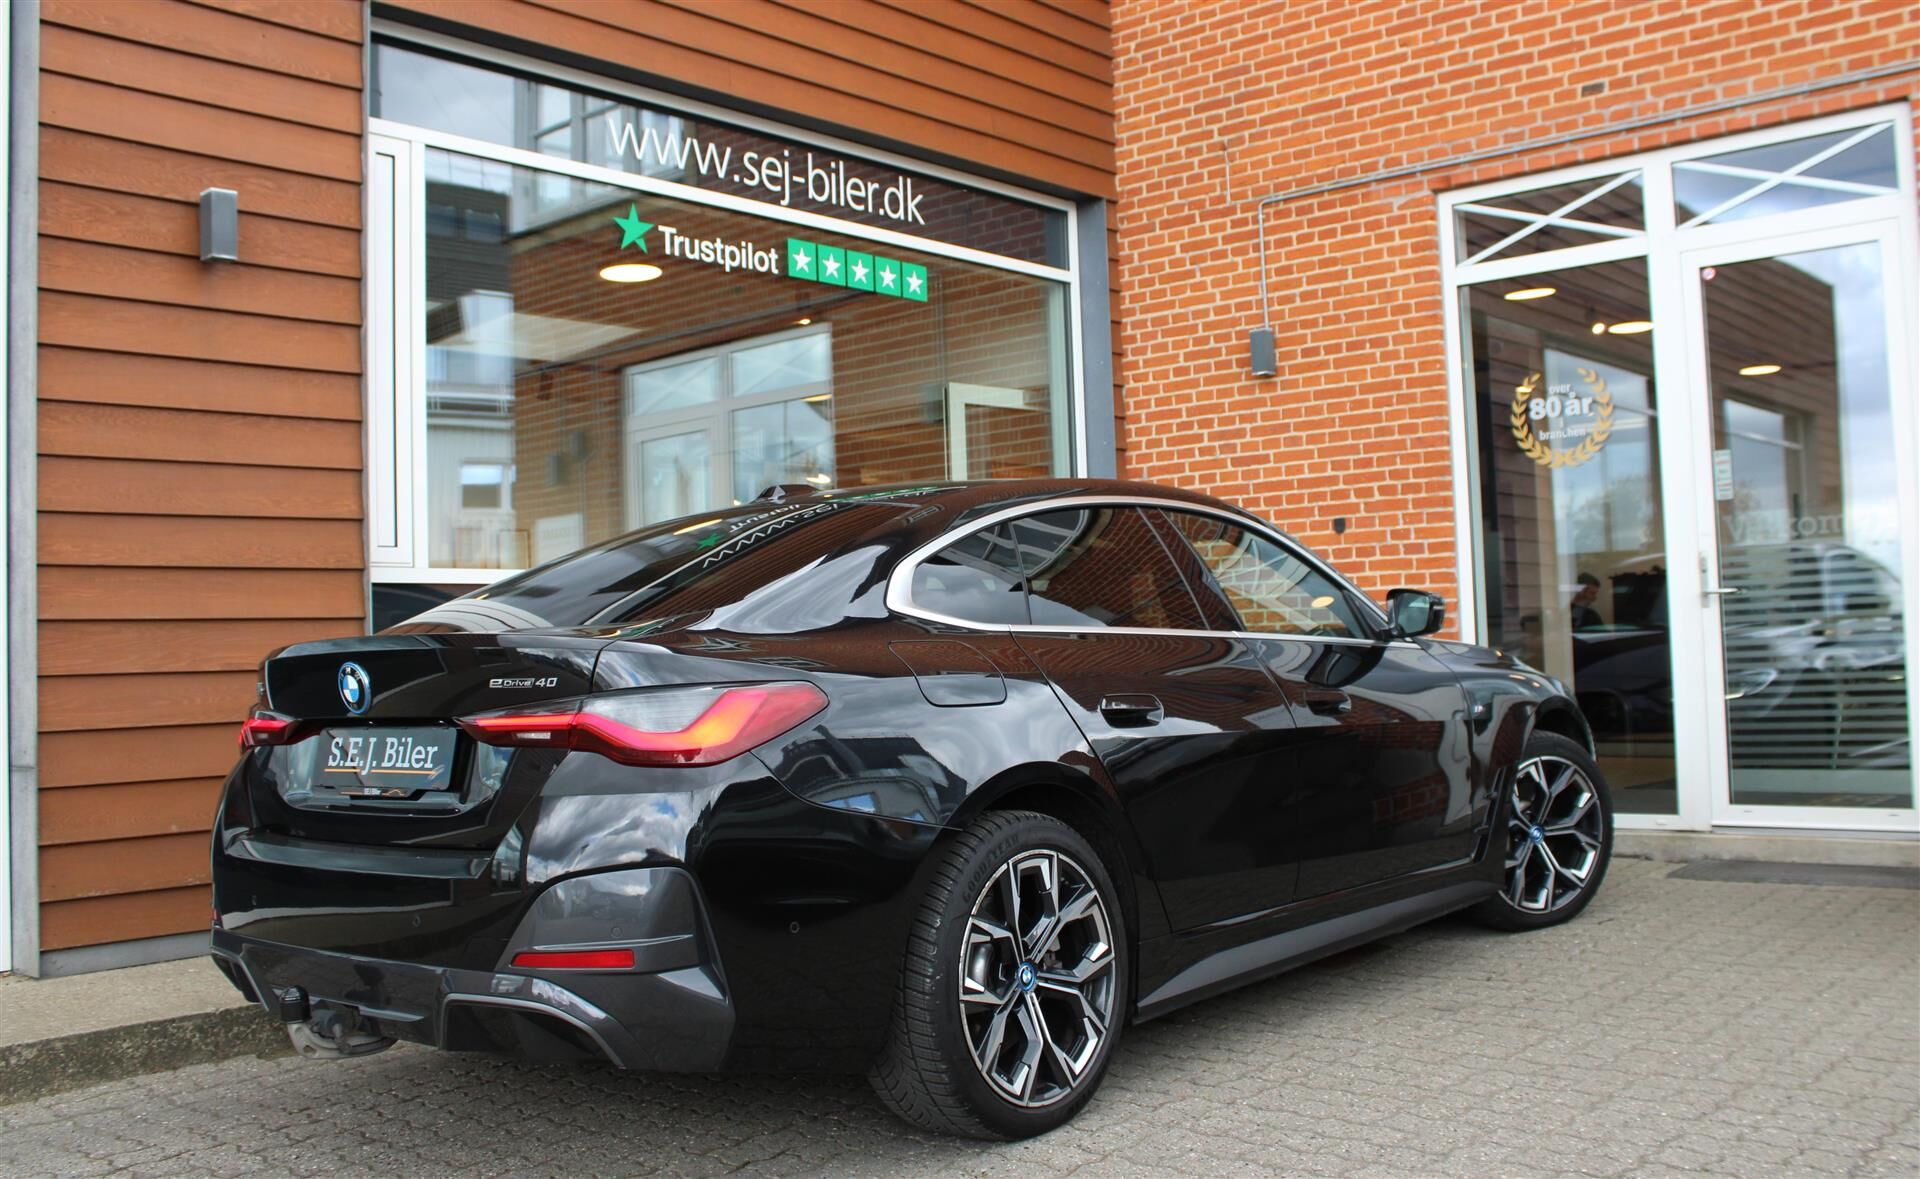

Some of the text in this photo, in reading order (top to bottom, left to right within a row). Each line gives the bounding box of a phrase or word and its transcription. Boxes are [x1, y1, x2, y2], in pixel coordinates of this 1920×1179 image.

[608, 118, 925, 225] www.sej-biler.dk
[658, 224, 779, 275] Trustpilot
[1548, 383, 1571, 394] over
[1529, 391, 1593, 420] 80 år
[535, 677, 558, 688] 40
[327, 737, 439, 775] S.E.J. Biler
